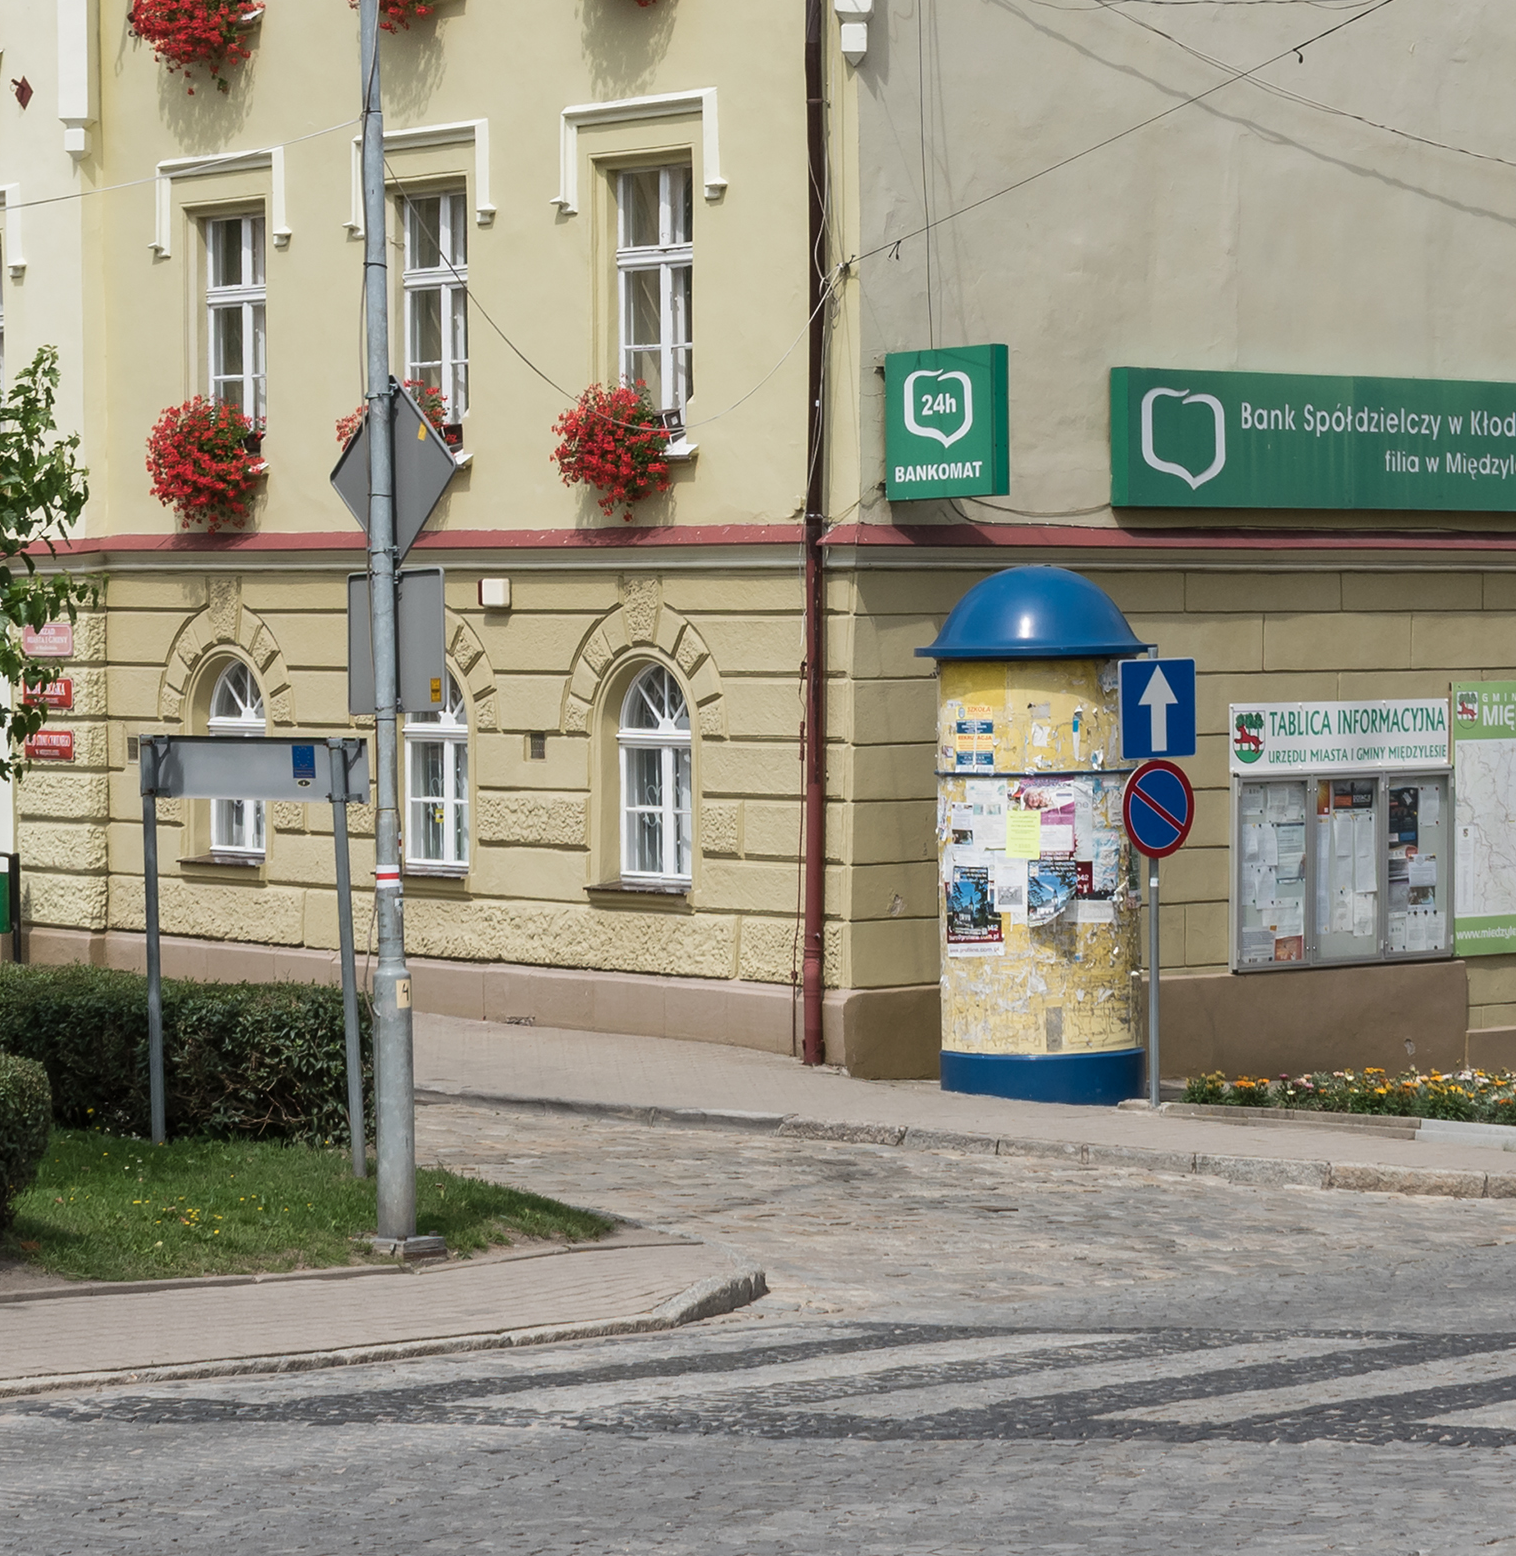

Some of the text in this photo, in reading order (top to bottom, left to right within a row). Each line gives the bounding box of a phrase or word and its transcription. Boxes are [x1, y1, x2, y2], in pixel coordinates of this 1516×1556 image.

[921, 393, 956, 415] 24h
[1241, 402, 1297, 431] Bank
[1304, 403, 1441, 440] Spółdzielczy
[1448, 415, 1463, 435] w
[895, 461, 982, 483] BANKOMAT
[1385, 450, 1419, 473] filia
[1425, 455, 1439, 473] w
[1269, 707, 1446, 737] TABLICA INFORMACYJNA
[1268, 749, 1307, 766] URZĘDU
[1310, 748, 1348, 762] MIASTA
[1356, 746, 1386, 761] GMINY
[1388, 744, 1447, 762] MIĘDZYLESIE
